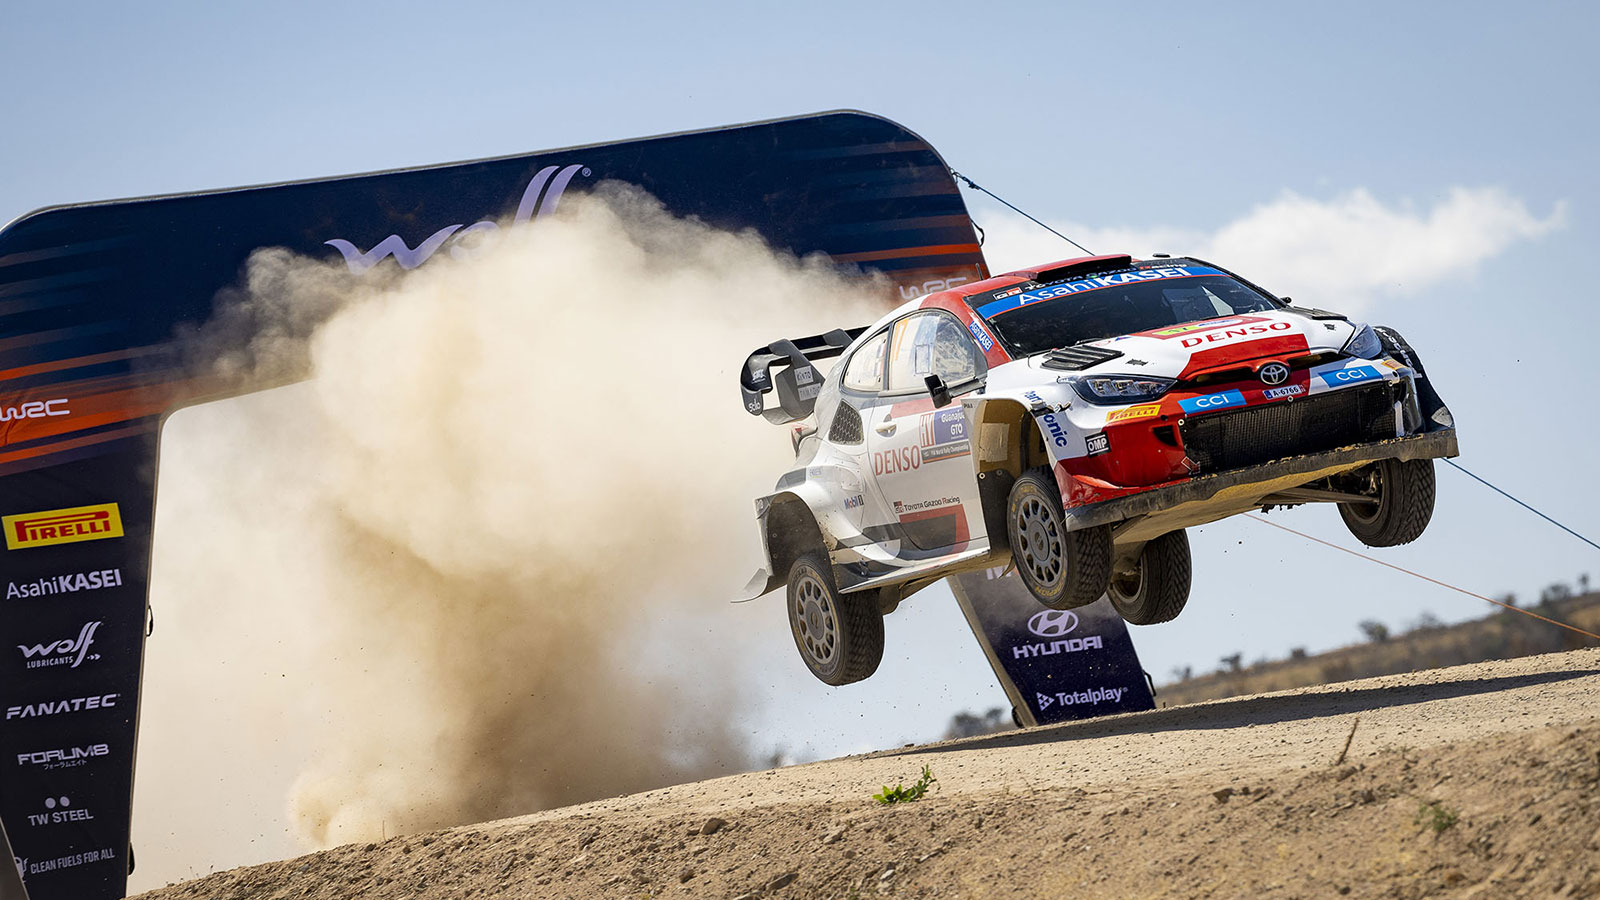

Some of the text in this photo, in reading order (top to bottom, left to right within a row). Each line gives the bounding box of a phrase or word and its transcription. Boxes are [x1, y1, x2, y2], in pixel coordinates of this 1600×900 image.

[1019, 267, 1192, 305] AsahiKASEI
[1180, 322, 1292, 348] DENSO
[1335, 368, 1368, 382] CCI
[0, 398, 70, 421] WRC
[1195, 394, 1230, 408] CCI
[1109, 406, 1156, 420] PIRELLI
[950, 423, 963, 436] GTO
[1087, 438, 1107, 451] OMP
[873, 445, 920, 476] DENSO
[843, 495, 858, 510] Mobil
[904, 502, 924, 512] TOYOTA
[923, 499, 942, 508] GAZOO
[942, 496, 960, 504] Racing
[14, 510, 111, 542] PIRELLI
[6, 568, 122, 600] AsahiKASEI
[17, 621, 102, 668] wolf
[1012, 635, 1104, 659] HYUNDAI
[26, 656, 74, 669] LUBRICANTS
[6, 693, 117, 720] FANATEC
[1055, 686, 1123, 707] Totalplay
[17, 743, 110, 765] FORUM8
[27, 808, 94, 826] TW STEEL
[30, 847, 115, 874] CLEAN FUELS FOR ALL
